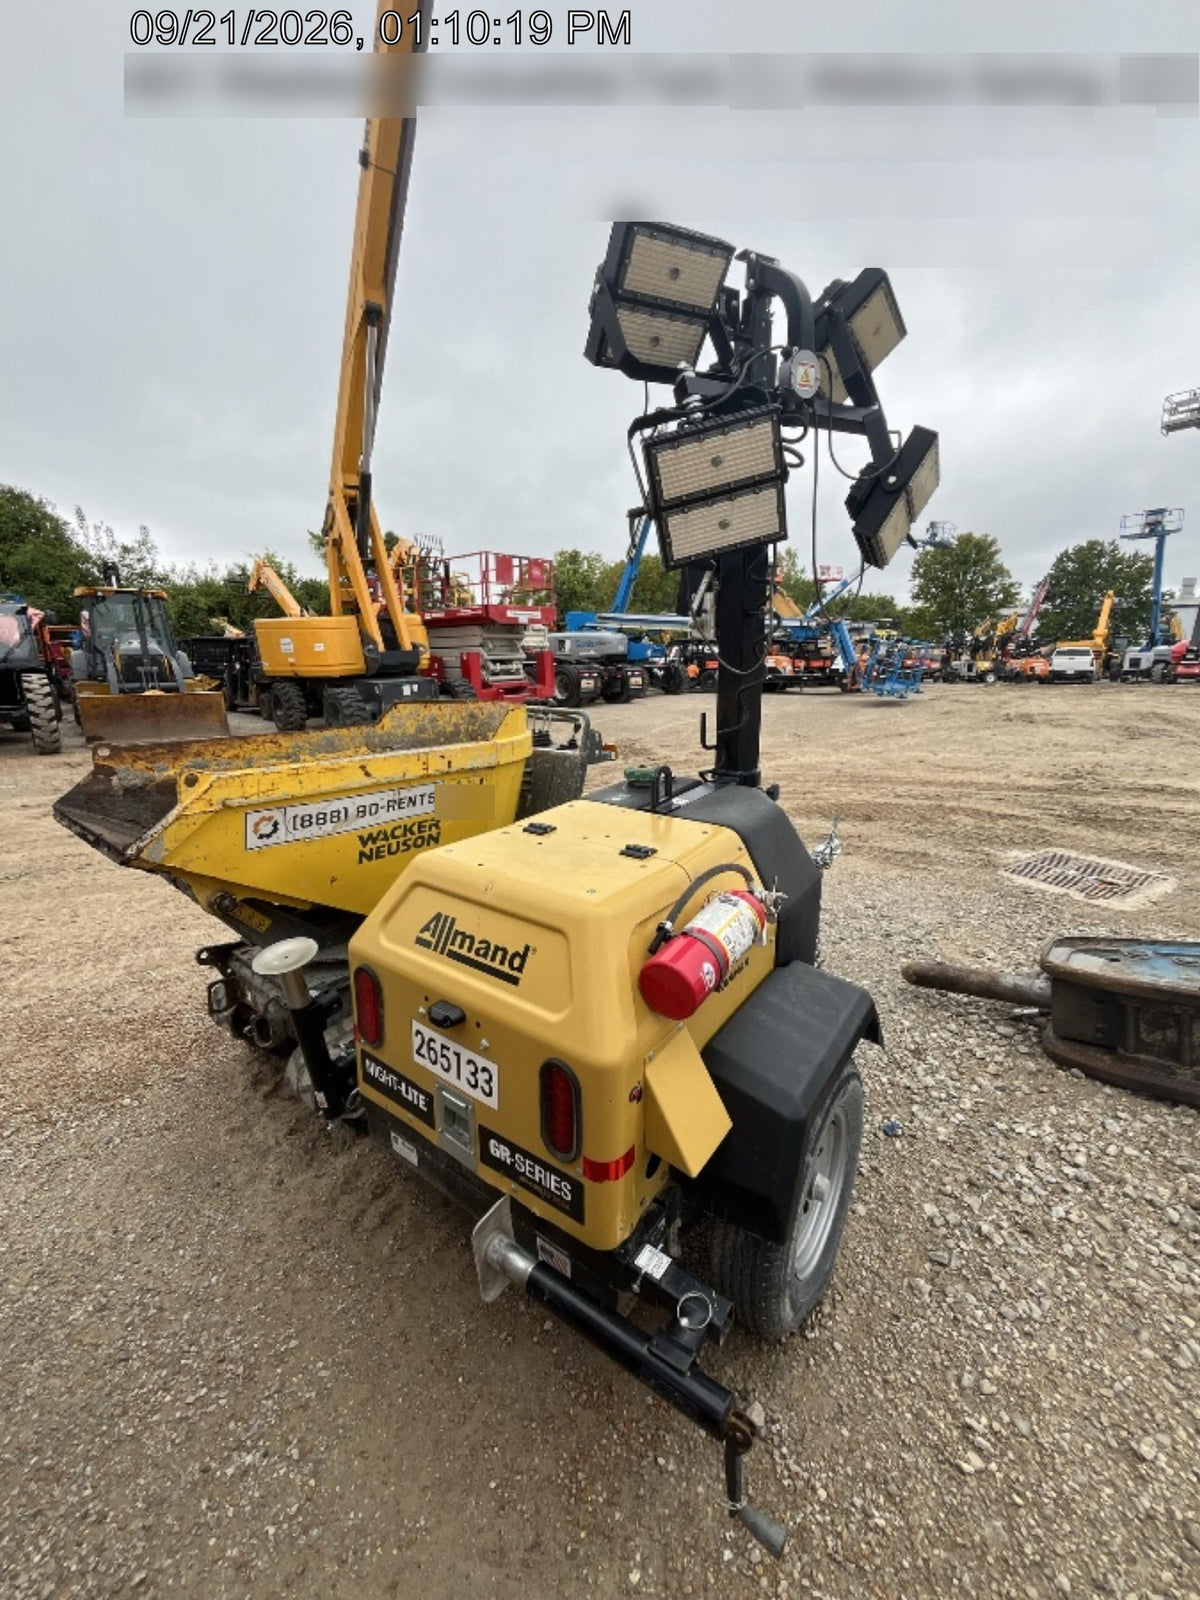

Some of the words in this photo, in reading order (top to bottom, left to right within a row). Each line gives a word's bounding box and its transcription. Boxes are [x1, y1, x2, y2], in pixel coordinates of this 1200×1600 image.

[357, 818, 441, 848] WACKER
[358, 831, 441, 865] NEUSON
[415, 911, 530, 975] Allmand
[365, 1058, 428, 1112] NIGHT-LITE
[414, 1029, 494, 1099] 265133
[488, 1138, 572, 1201] GR-SERIES
